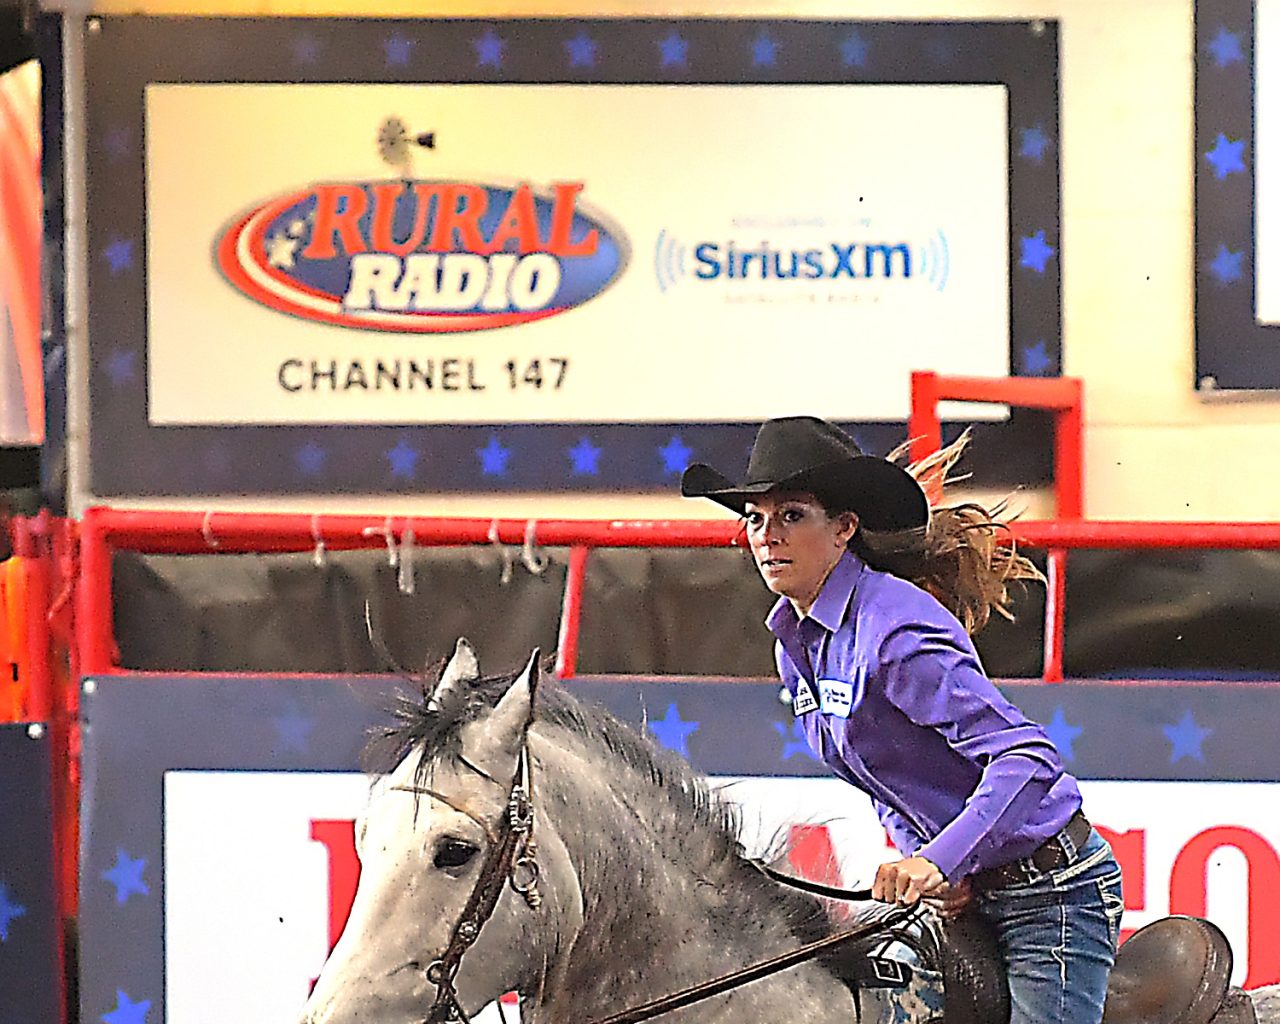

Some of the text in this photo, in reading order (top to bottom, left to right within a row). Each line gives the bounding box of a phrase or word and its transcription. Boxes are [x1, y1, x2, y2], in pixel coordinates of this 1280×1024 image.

[303, 182, 599, 259] RURAL
[343, 253, 562, 311] RADIO
[278, 358, 569, 392] CHANNEL 147
